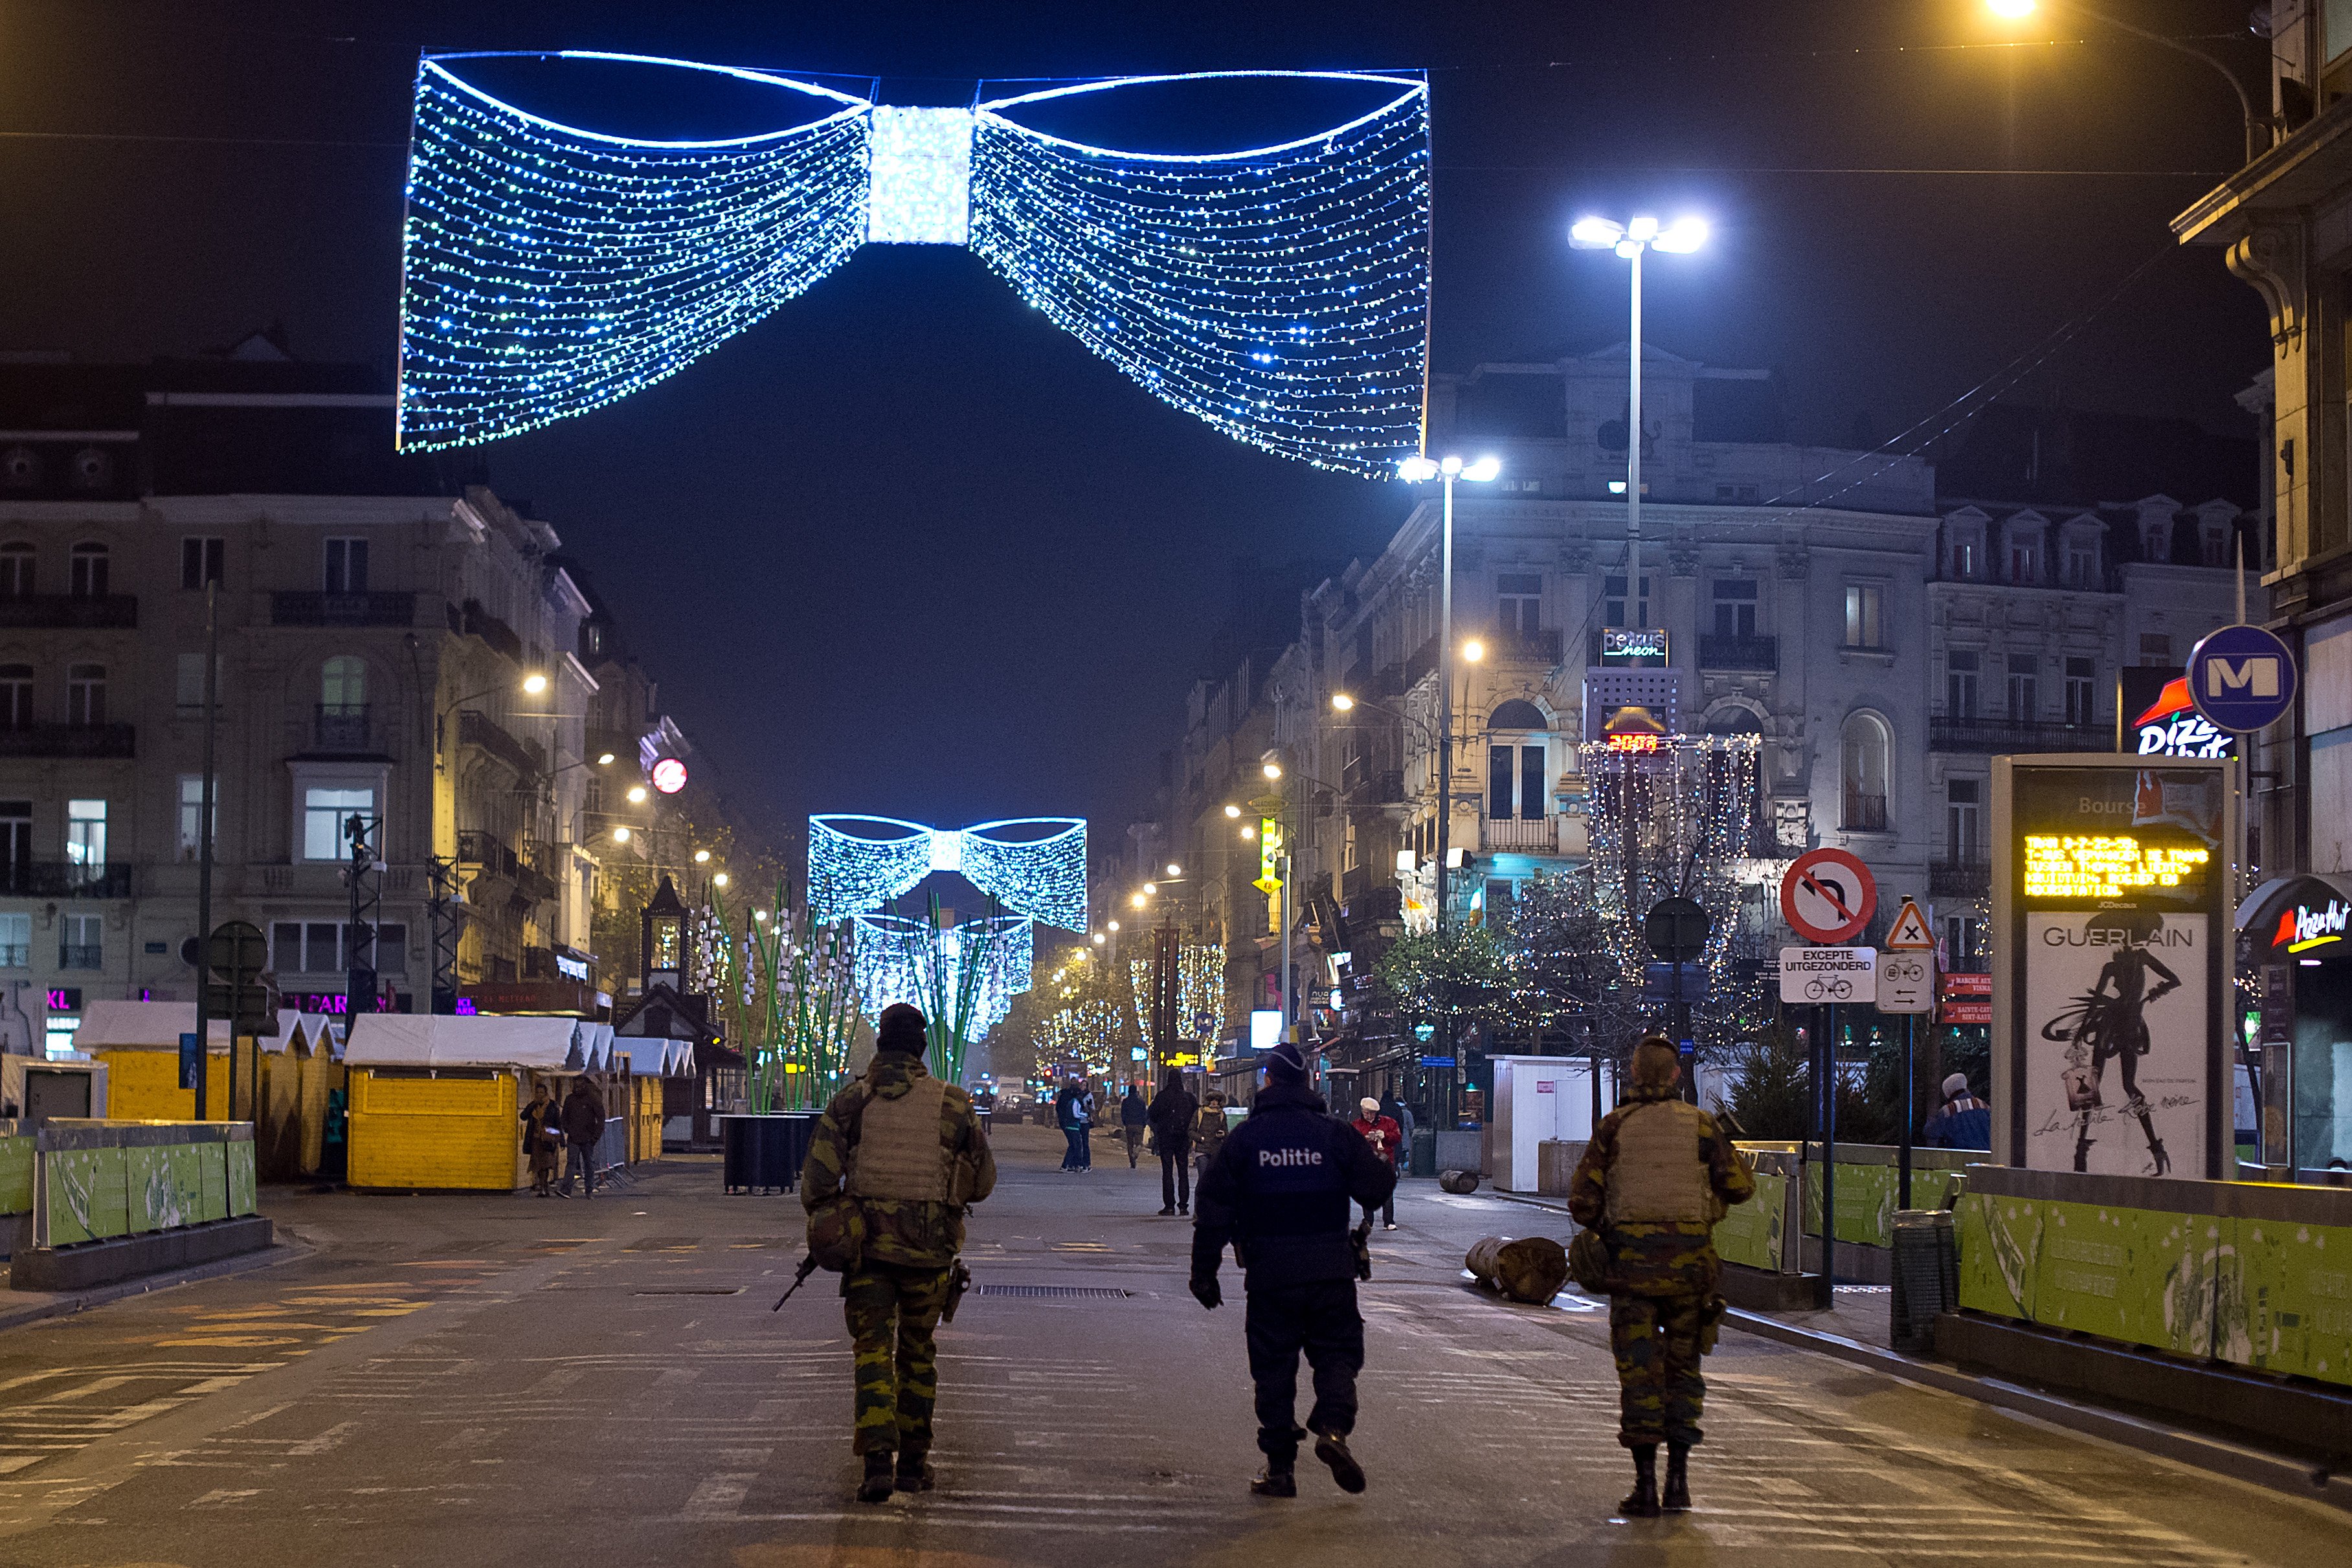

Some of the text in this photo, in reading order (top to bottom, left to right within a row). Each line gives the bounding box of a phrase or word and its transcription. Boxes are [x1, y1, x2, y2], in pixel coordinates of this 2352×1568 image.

[1604, 632, 1664, 651] petrus
[1607, 645, 1664, 656] neon
[2208, 658, 2279, 697] M
[2138, 711, 2219, 756] Pizz
[2079, 797, 2146, 814] Bourse
[2098, 901, 2138, 909] JCDecaux
[2295, 899, 2351, 943] Pizza Hut
[2043, 927, 2193, 947] GUERLAIN
[1803, 950, 1854, 960] EXCEPTE
[1786, 961, 1871, 971] UITGEZONDERD
[309, 994, 348, 1014] PAR
[457, 998, 471, 1007] ICI
[1259, 1148, 1323, 1167] Politie
